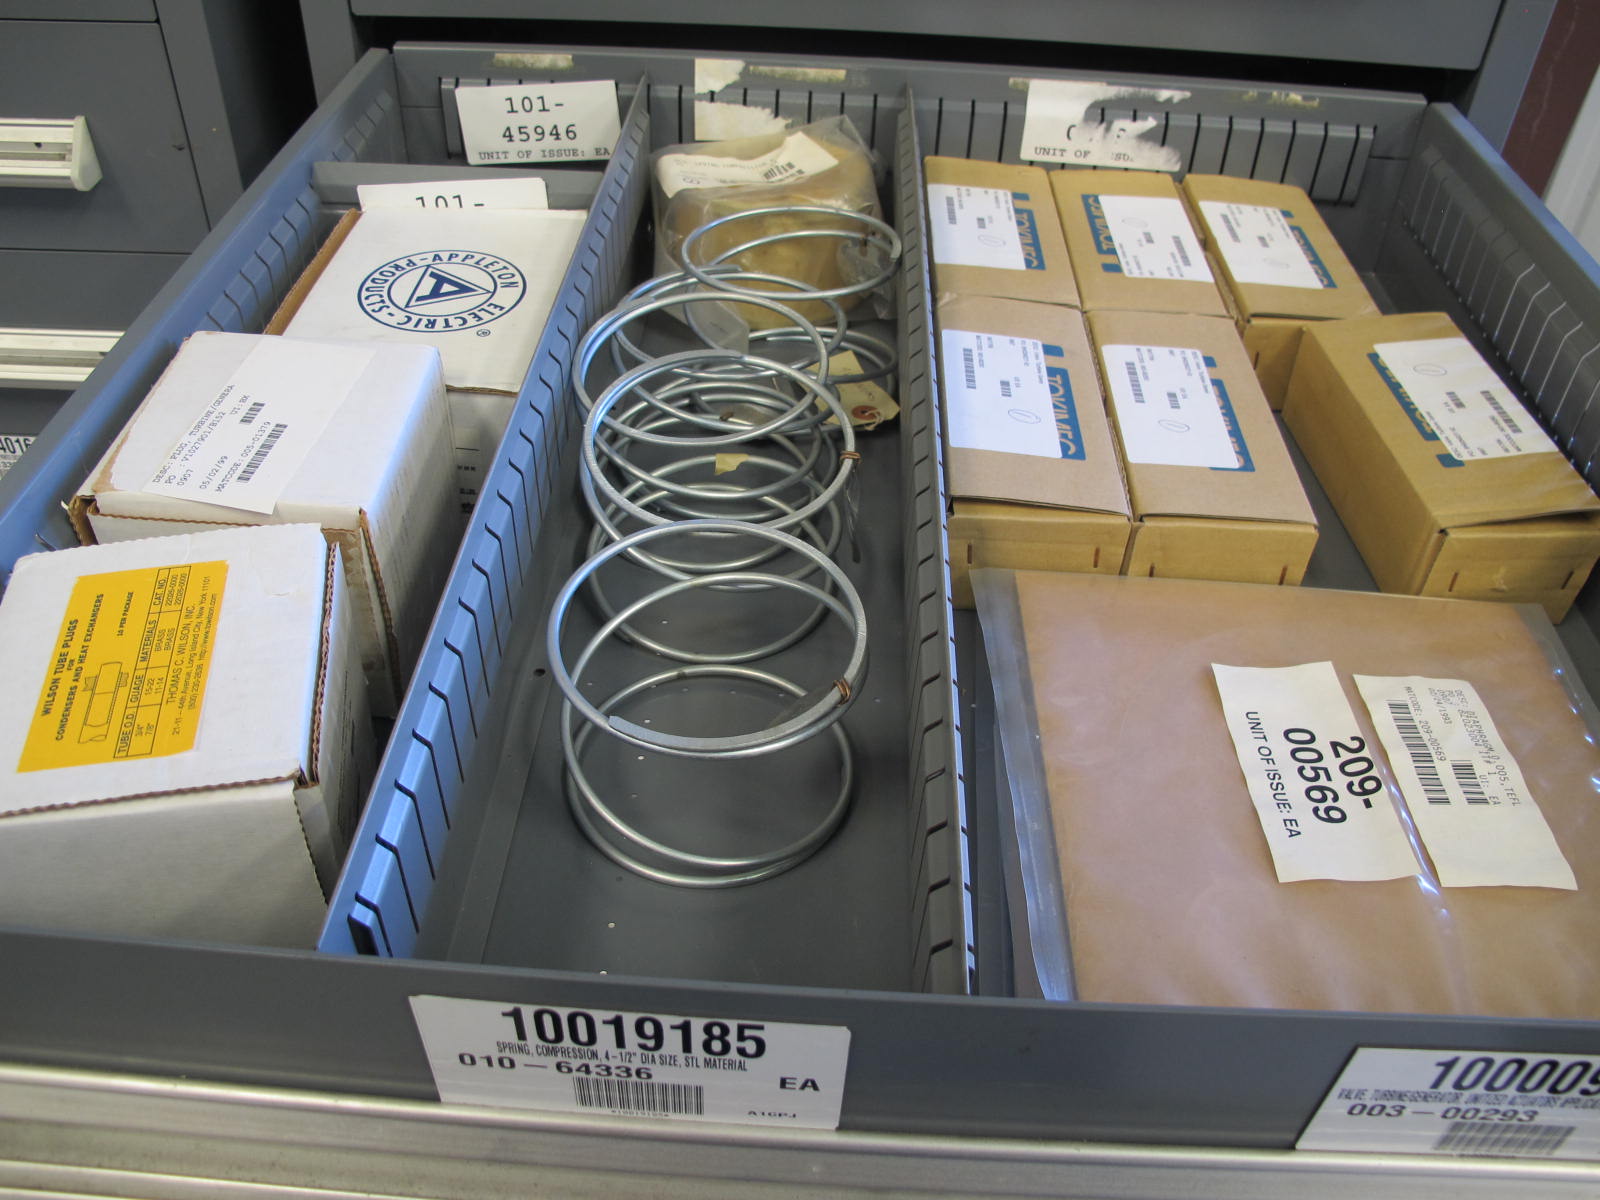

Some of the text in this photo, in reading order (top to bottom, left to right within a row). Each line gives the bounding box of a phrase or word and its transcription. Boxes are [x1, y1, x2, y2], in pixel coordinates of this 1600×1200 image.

[505, 96, 564, 113] 101-
[502, 124, 577, 142] 45946
[478, 147, 610, 160] UNIT OF ISSUE: EA
[1034, 147, 1091, 159] UNIT OF
[364, 258, 418, 314] PRODUCTS
[431, 253, 519, 289] APPLETON
[396, 302, 506, 330] ELECTRIC
[152, 590, 163, 605] CAT.
[139, 619, 156, 661] MATERIALS
[41, 618, 79, 715] WILSON TUBE PLUGS
[55, 593, 103, 740] CONDENSERS AND HEAT EXCHANGERS
[165, 666, 182, 703] THOMAS
[117, 728, 131, 753] TUBE
[1418, 720, 1447, 762] 209-00569
[1245, 711, 1301, 838] UNIT OF ISSUE: EA
[1283, 728, 1347, 823] 00569
[1330, 736, 1382, 808] 209-
[501, 1007, 766, 1058] 10019185
[458, 1052, 516, 1070] 010
[555, 1060, 653, 1080] 64336
[496, 1041, 532, 1057] SPRING,
[536, 1044, 602, 1062] COMPRESSION,
[641, 1052, 657, 1065] DIA
[659, 1054, 682, 1069] SIZE,
[685, 1056, 700, 1068] STL
[704, 1057, 748, 1071] MATERIAL
[779, 1076, 820, 1092] EA
[1347, 1103, 1405, 1118] 003
[1440, 1106, 1540, 1123] 00293
